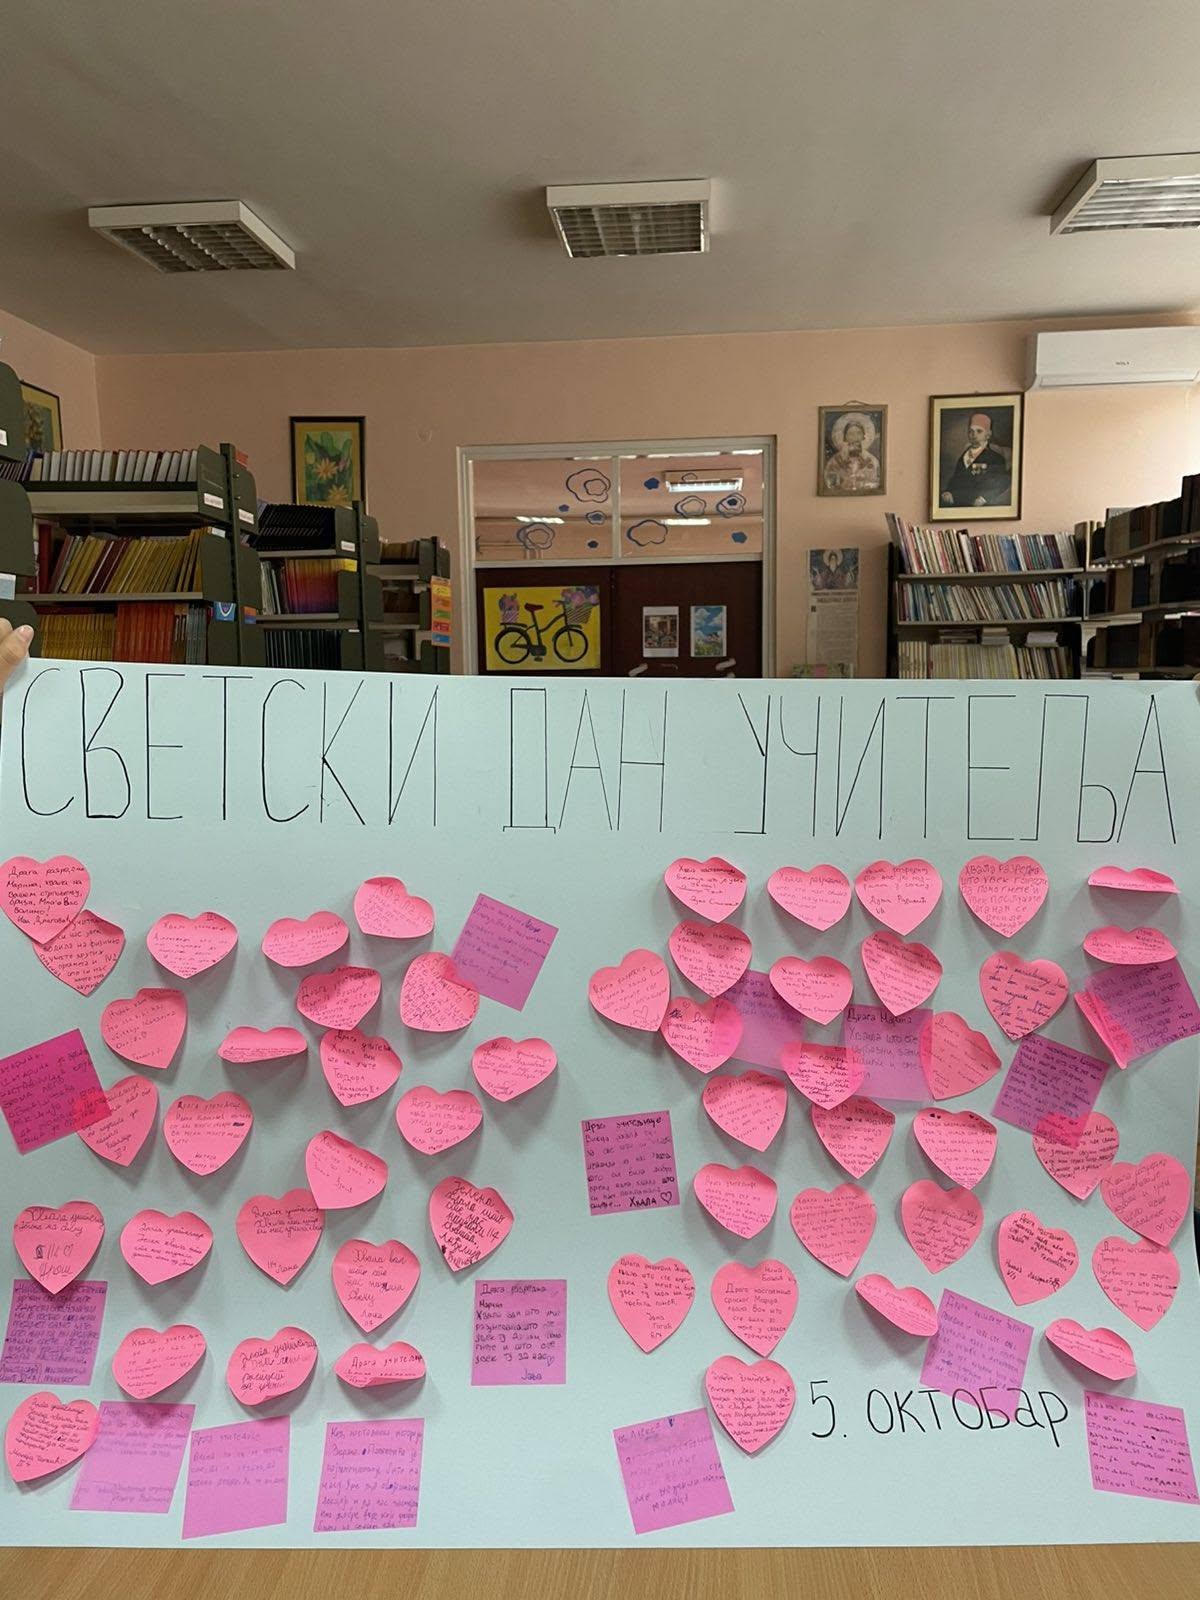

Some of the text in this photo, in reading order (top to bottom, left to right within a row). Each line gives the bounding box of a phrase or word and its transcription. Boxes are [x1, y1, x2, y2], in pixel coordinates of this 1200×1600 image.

[22, 667, 1177, 844] СВЕТСКИ ДАН УЧИТЕЉА
[9, 866, 38, 879] Драга
[810, 1380, 848, 1438] 5.
